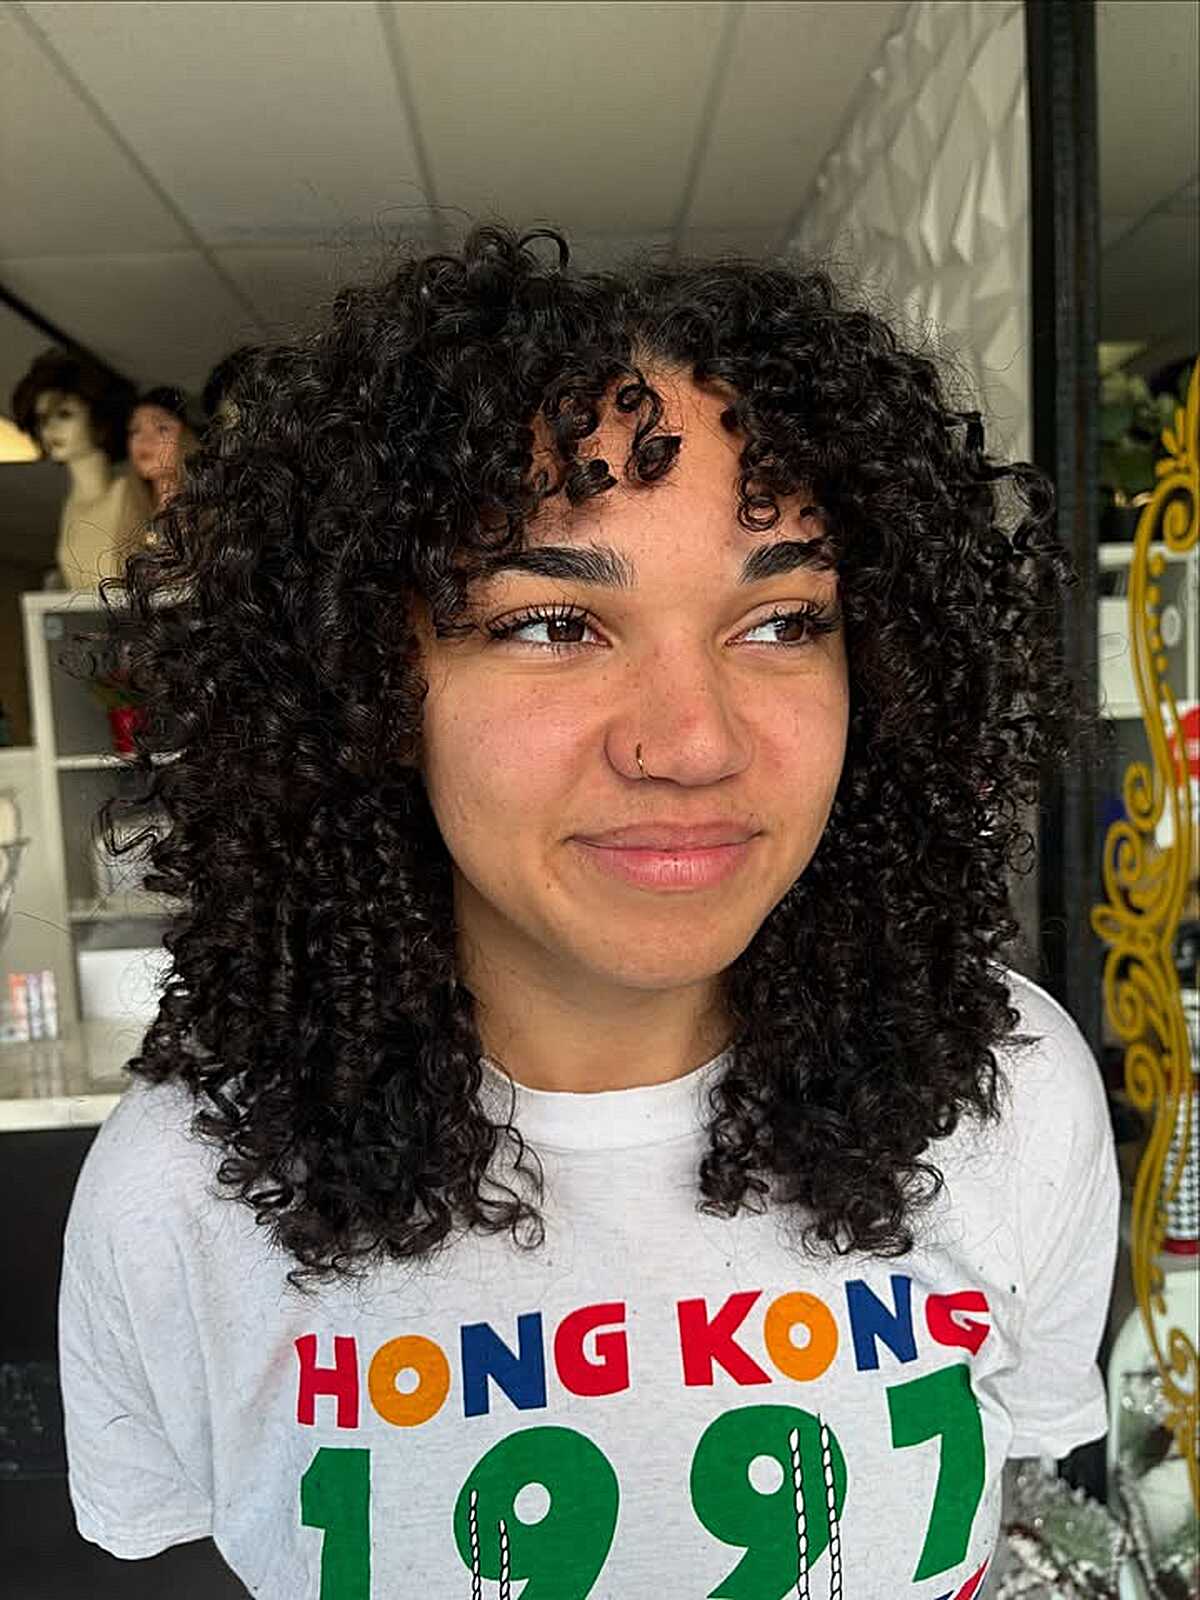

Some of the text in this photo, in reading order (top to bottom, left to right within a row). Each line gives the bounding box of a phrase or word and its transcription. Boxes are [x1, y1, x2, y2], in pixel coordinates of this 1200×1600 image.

[295, 1275, 991, 1428] HONG KONG
[301, 1364, 986, 1600] 1997
